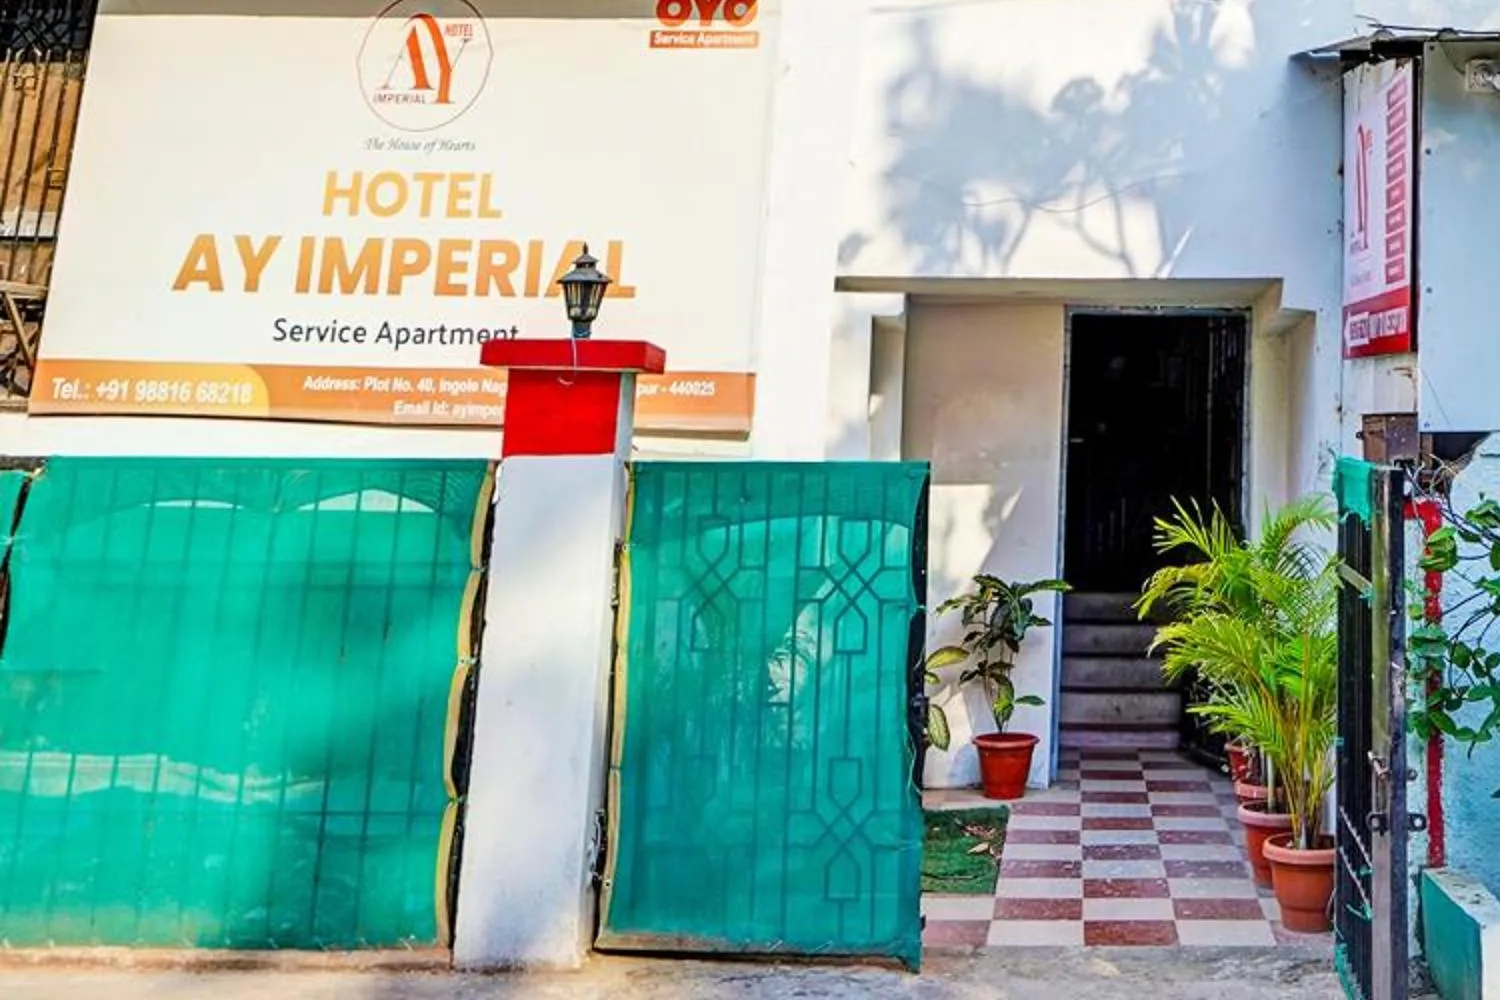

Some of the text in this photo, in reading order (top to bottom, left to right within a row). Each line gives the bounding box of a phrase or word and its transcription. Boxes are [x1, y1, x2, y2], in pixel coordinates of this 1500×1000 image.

[373, 92, 427, 105] IMPERIAL
[322, 171, 503, 219] HOTEL
[172, 234, 282, 293] AY
[273, 317, 518, 350] Service Apartment
[96, 379, 129, 400] +91
[134, 380, 191, 402] 98816
[304, 376, 360, 391] Address:
[364, 377, 390, 392] Plot
[482, 379, 508, 398] Nag
[636, 384, 658, 399] pur
[394, 401, 429, 416] Email
